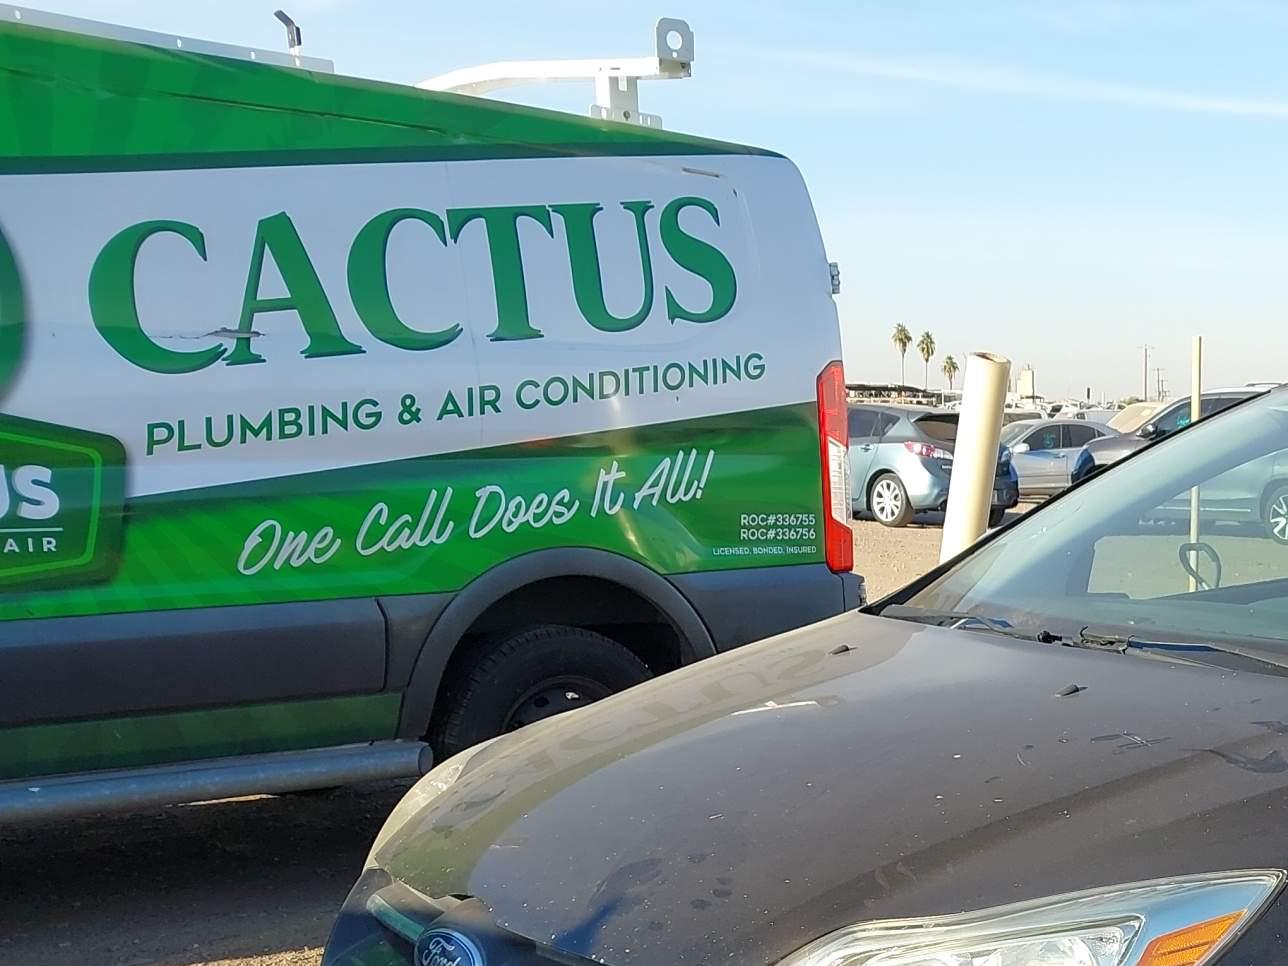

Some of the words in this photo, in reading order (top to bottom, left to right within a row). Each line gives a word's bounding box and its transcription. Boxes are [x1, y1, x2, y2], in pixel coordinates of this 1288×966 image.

[88, 196, 738, 374] CACTUS
[145, 397, 383, 456] PLUMBING
[398, 394, 423, 425] &
[437, 384, 502, 421] AIR
[516, 352, 767, 409] CONDITIONING
[237, 518, 342, 576] One
[354, 485, 455, 556] Call
[467, 484, 580, 539] Does
[590, 459, 627, 518] It
[632, 447, 716, 511] All!
[740, 514, 816, 526] ROC#336755
[740, 528, 816, 540] ROC#336756
[4, 537, 57, 553] AIR
[786, 545, 816, 553] INSURED
